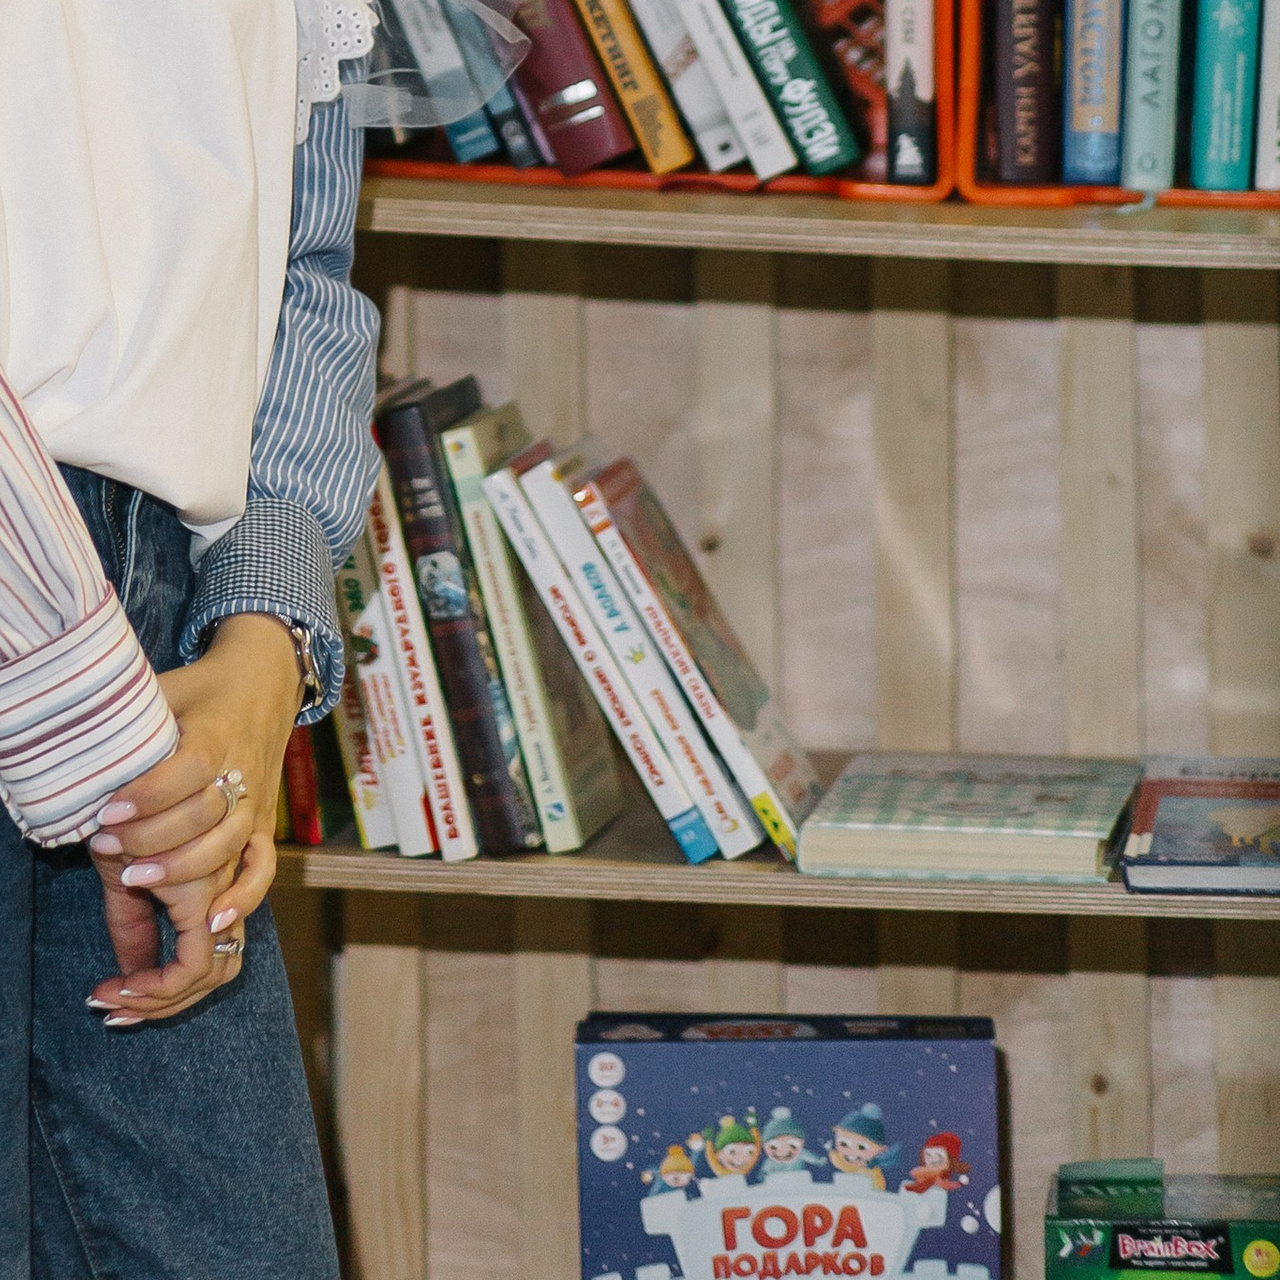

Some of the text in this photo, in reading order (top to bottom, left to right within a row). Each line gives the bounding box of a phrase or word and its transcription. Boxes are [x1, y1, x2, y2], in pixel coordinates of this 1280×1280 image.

[772, 71, 848, 167] ФУДЗИ
[579, 560, 621, 622] ВОЛКОВ
[380, 559, 428, 707] ИЗУМРУДНОГО
[417, 713, 460, 840] ВОЛШЕБНИК
[721, 1203, 868, 1250] ГОРА
[1118, 1233, 1220, 1261] BrainBox
[712, 1251, 885, 1280] ПОДАРКОВ
